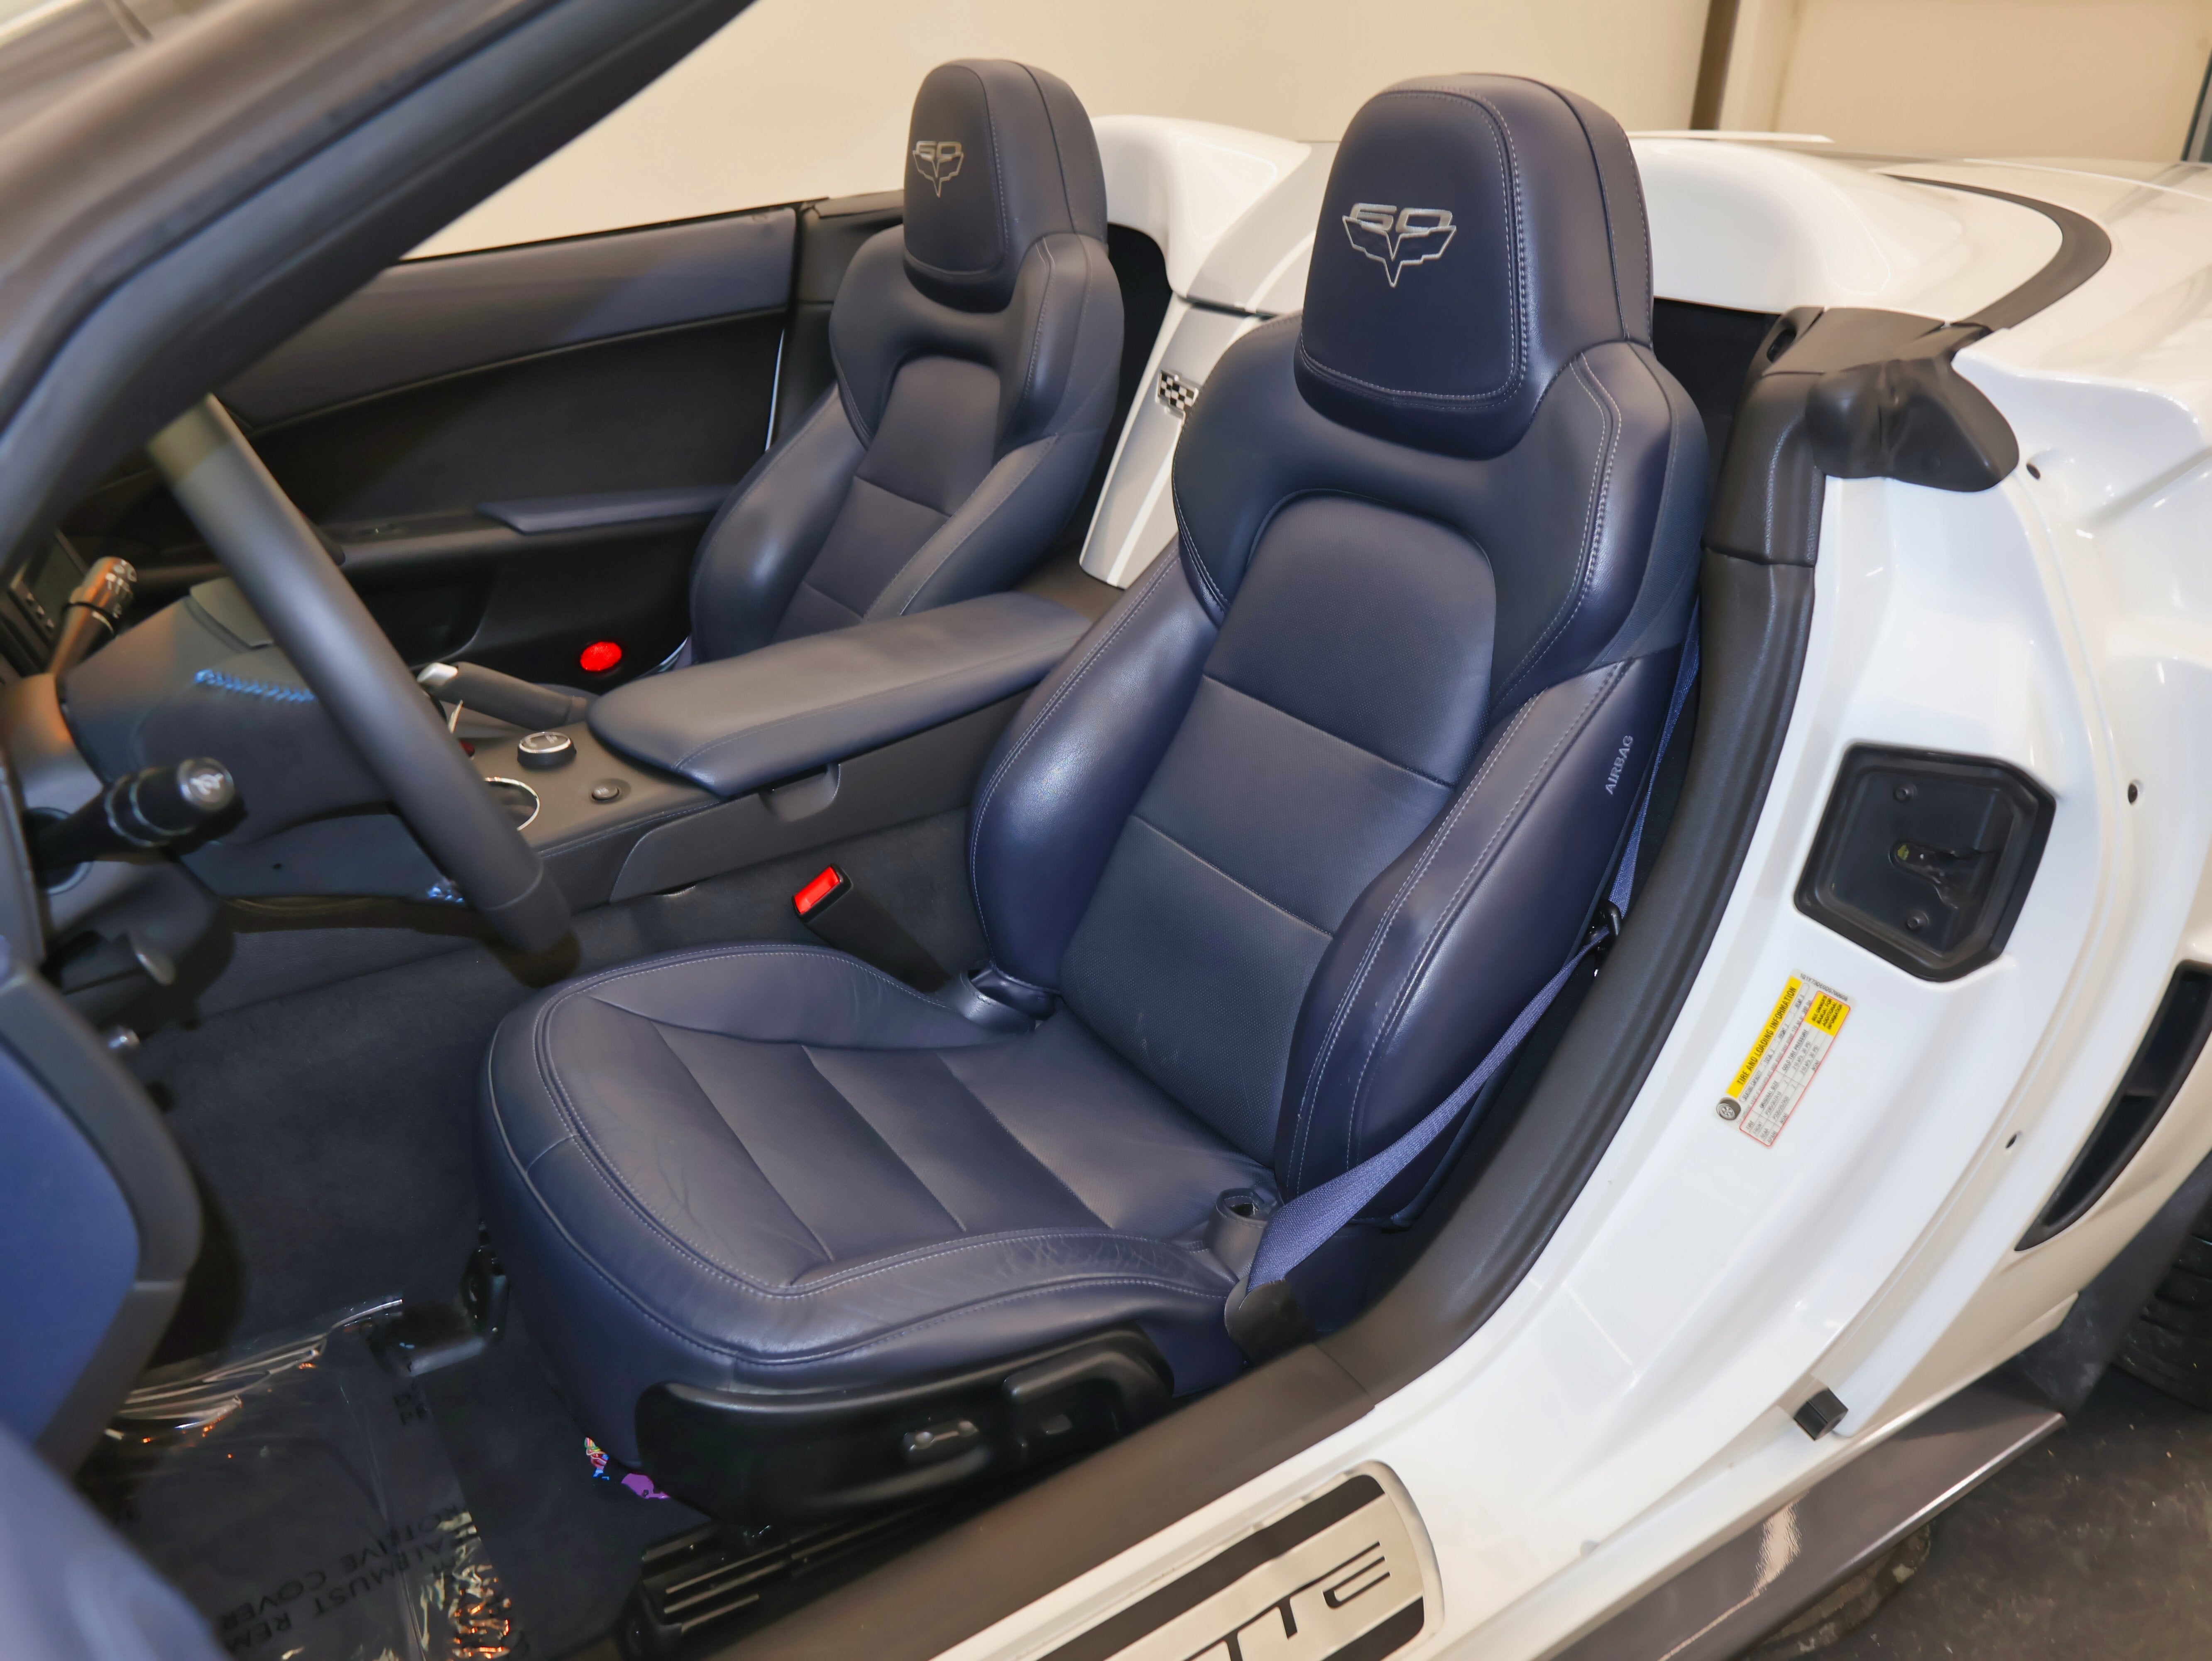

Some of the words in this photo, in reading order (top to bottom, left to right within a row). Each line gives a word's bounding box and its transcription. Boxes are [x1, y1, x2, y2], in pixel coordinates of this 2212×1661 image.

[1605, 735, 1633, 795] AIRBAG
[1794, 998, 1802, 1008] REAR
[1821, 1001, 1837, 1026] ADDITIONAL
[1736, 1070, 1749, 1085] TIRE
[1745, 1056, 1758, 1071] AND
[1753, 1029, 1774, 1057] LOADING
[1769, 986, 1796, 1029] INFORMATION
[1777, 1027, 1787, 1039] FRONT
[1781, 1059, 1791, 1071] COLD
[1793, 1029, 1808, 1051] PRESSURE
[1763, 1053, 1772, 1063] TOTAL
[1811, 1059, 1820, 1071] NONE
[1759, 1089, 1773, 1108] ORIGINAL
[1779, 1112, 1788, 1124] NONE
[1745, 1120, 1754, 1130] TIRE
[1752, 1121, 1763, 1134] FRONT
[1759, 1127, 1769, 1139] REAR
[1767, 1130, 1777, 1143] SPARE
[314, 1563, 395, 1617] MUST
[223, 1571, 326, 1630] COVER
